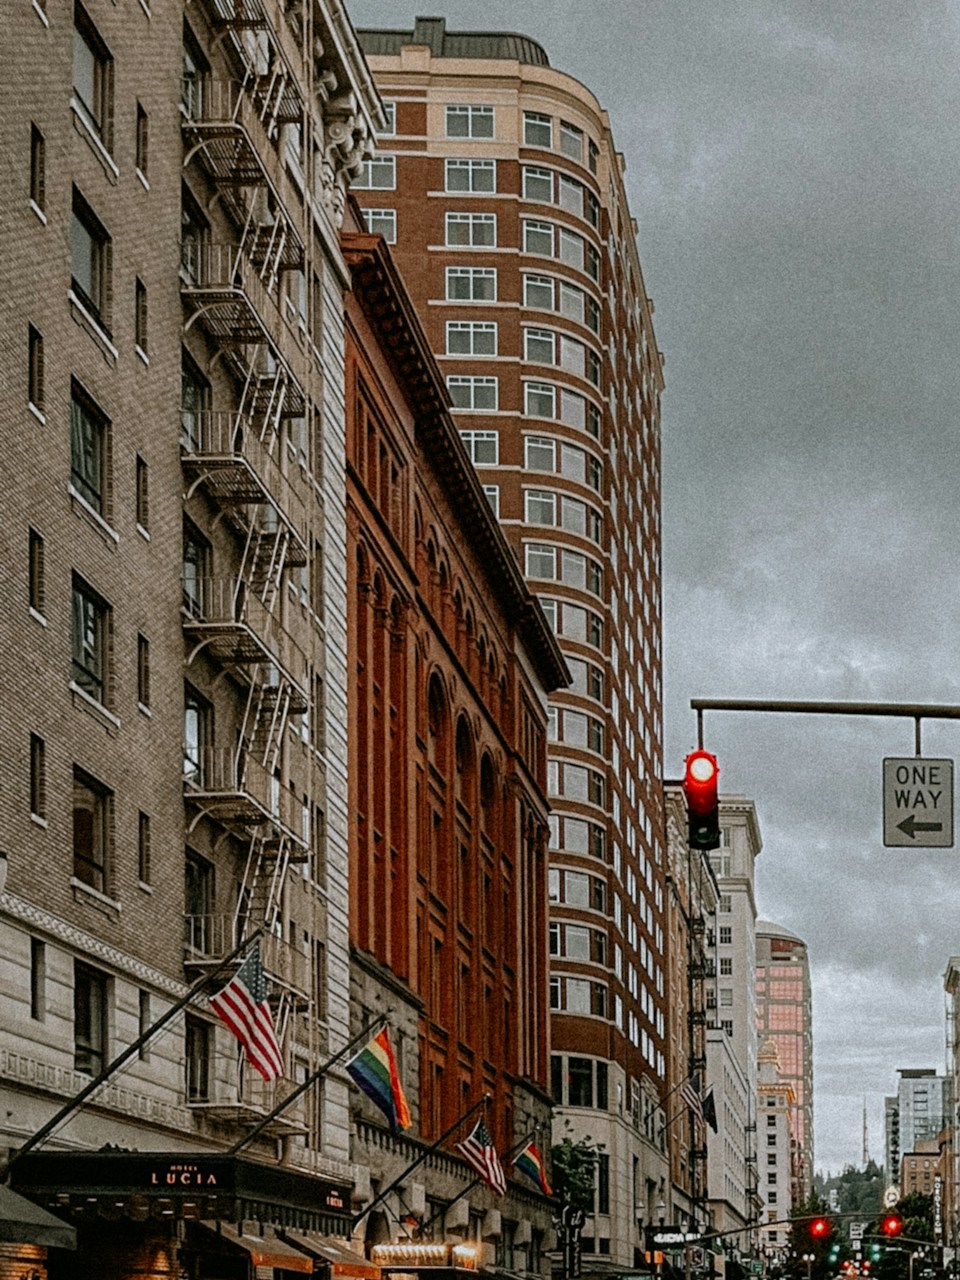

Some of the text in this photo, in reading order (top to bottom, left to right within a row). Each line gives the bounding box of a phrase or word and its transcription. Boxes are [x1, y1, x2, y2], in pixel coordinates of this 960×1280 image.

[896, 765, 941, 785] ONE
[894, 789, 943, 809] WAY
[151, 1172, 217, 1185] LUCIA
